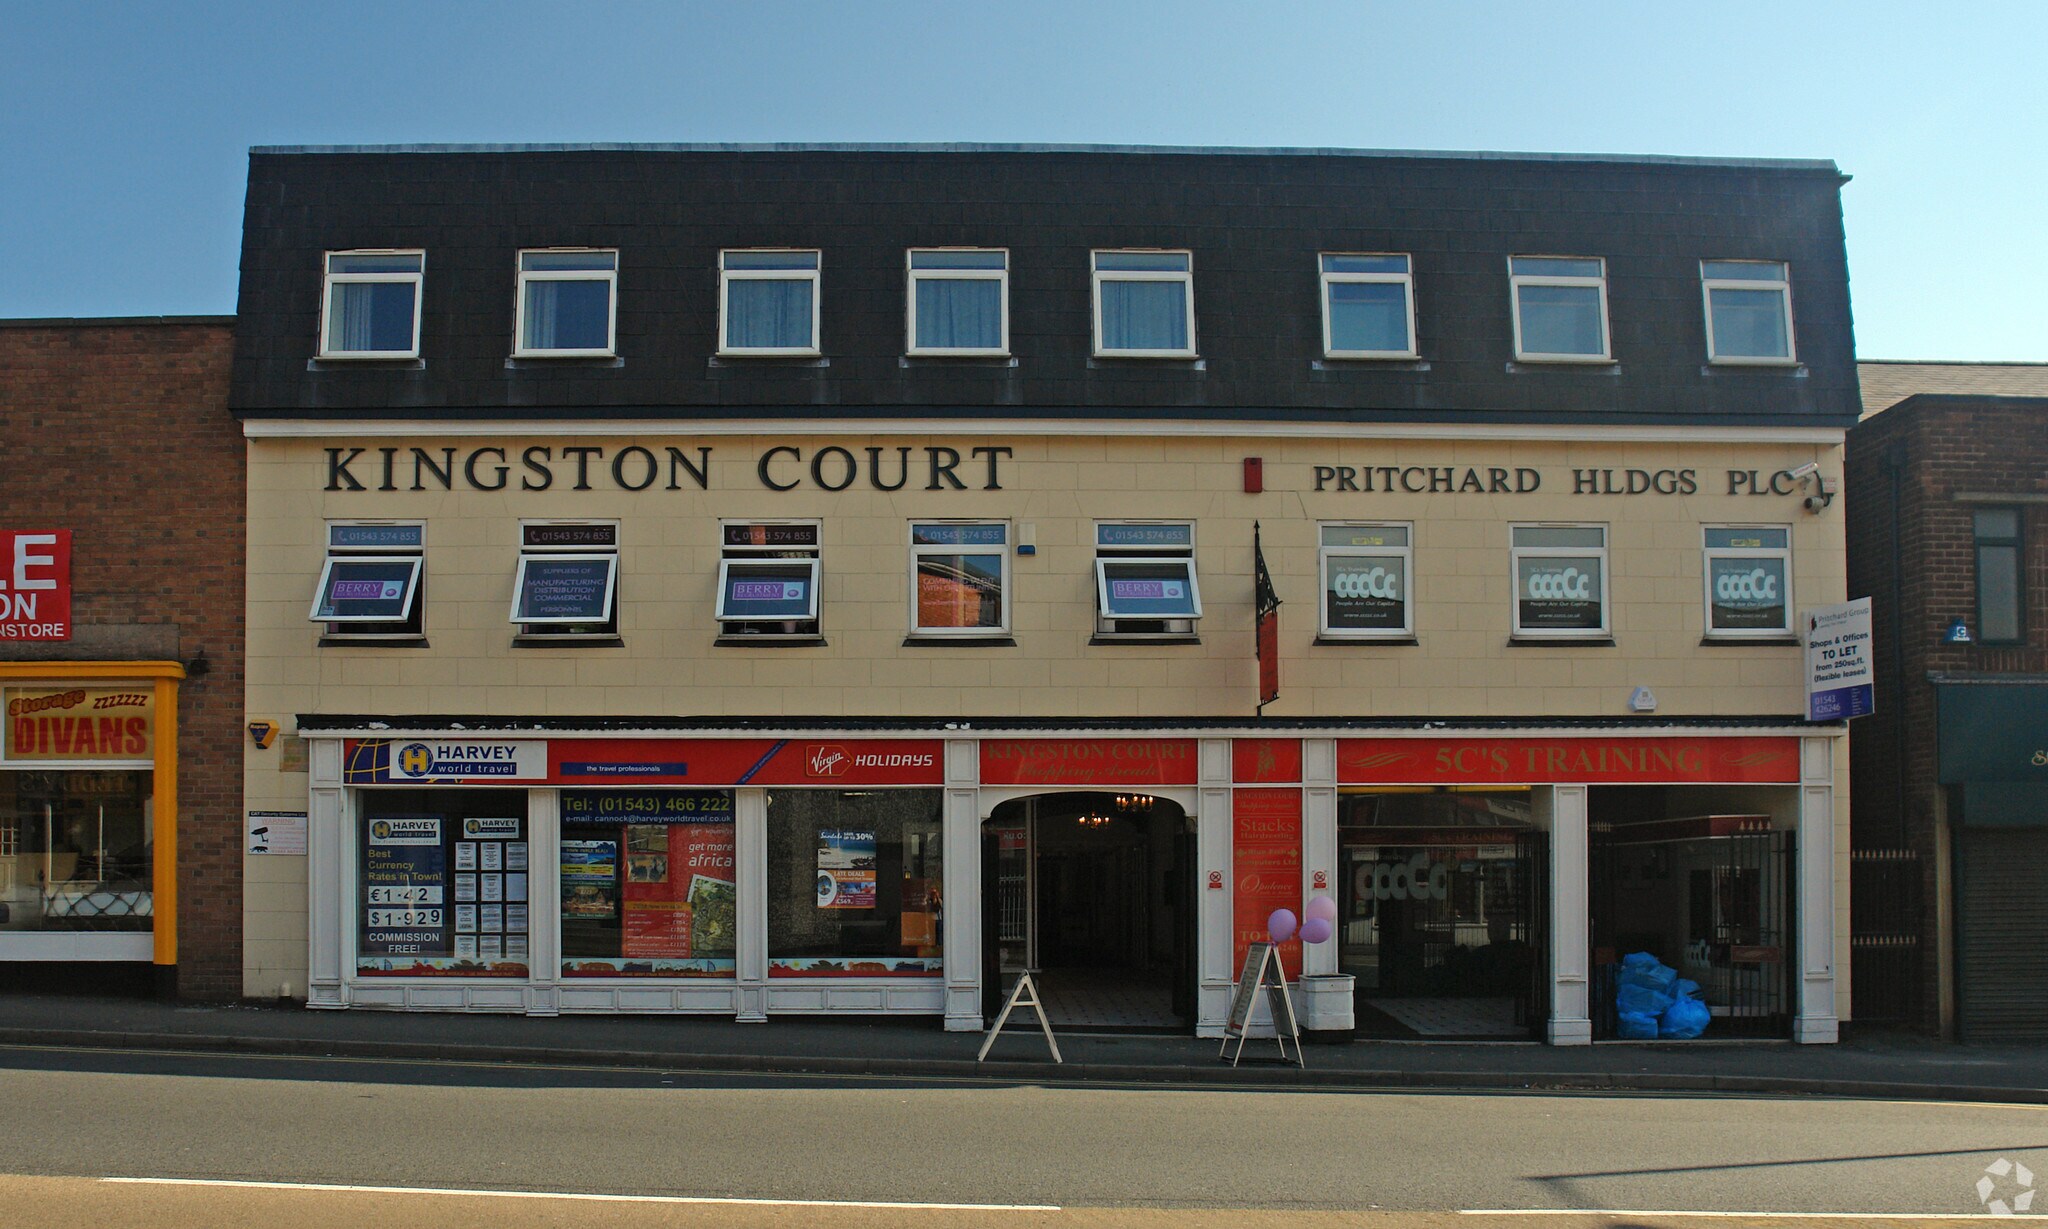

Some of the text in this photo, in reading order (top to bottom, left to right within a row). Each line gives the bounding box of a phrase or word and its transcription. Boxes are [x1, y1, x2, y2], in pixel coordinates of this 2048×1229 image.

[324, 446, 1013, 492] KINGSTON COURT
[1313, 465, 1541, 494] PRITCHARD
[1573, 467, 1697, 496] HLDGS
[1727, 469, 1795, 497] PLC
[349, 531, 417, 541] 01543 574 855
[542, 531, 610, 541] 01543 574 855
[743, 531, 811, 540] 01543 574 855
[930, 530, 999, 539] 01543 574 855
[1116, 531, 1184, 540] 01543 574 855
[0, 534, 57, 591] E
[337, 583, 381, 592] BERRY
[737, 584, 782, 593] BERRY
[1117, 583, 1160, 592] BERRY
[1818, 611, 1848, 624] Pritchard
[1848, 607, 1869, 618] Group
[1810, 632, 1869, 649] Shops & Offices
[1822, 645, 1858, 660] TO LET
[1815, 663, 1833, 672] from
[1814, 666, 1867, 683] (flexible leases)
[9, 689, 86, 716] Storage
[1814, 695, 1836, 705] 01543
[1815, 704, 1841, 714] 426246
[13, 716, 147, 755] DIVANS
[437, 745, 517, 759] HARVEY
[988, 743, 1189, 759] KINGSTON COURT
[811, 747, 933, 774] Virgin HOLIDAYS
[1434, 746, 1703, 773] 5C'S TRAINING
[438, 763, 513, 773] world travel
[586, 764, 661, 774] the travel professionals
[564, 797, 730, 814] Tel: (01543) 466 222
[392, 821, 436, 830] HARVEY
[482, 819, 516, 827] HARVEY
[1240, 818, 1295, 832] Stacks
[855, 832, 874, 841] 30%
[689, 843, 705, 853] get
[368, 850, 391, 858] Best
[688, 854, 733, 867] africa
[368, 861, 415, 872] Currency
[368, 872, 442, 881] Rates in Town!
[1240, 874, 1294, 893] Opulence
[369, 933, 440, 942] COMMISSION
[1240, 930, 1261, 941] TO
[388, 944, 420, 953] FREE!
